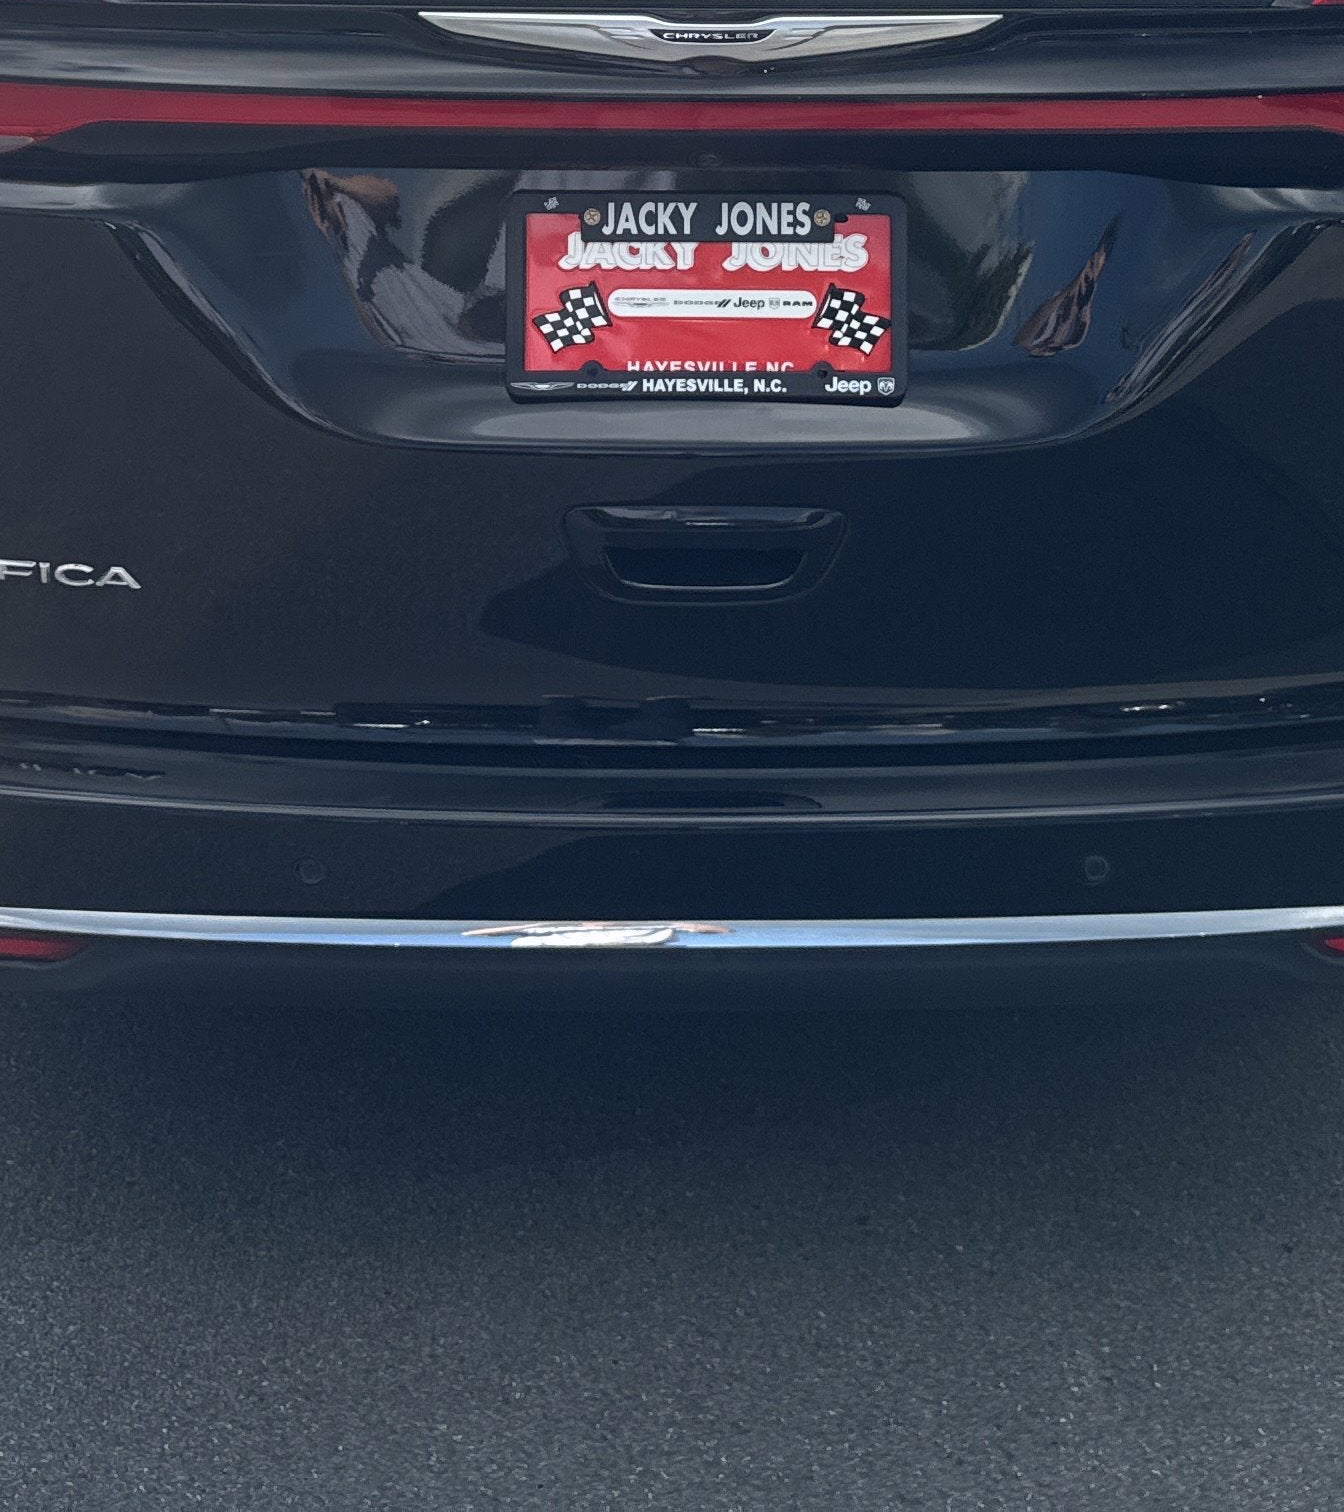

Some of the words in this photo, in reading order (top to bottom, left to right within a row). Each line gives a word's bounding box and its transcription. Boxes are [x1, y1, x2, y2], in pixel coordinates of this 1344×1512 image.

[662, 32, 759, 40] CHRYSLER
[601, 201, 698, 236] JACKY
[715, 201, 812, 236] JONES
[558, 233, 700, 271] JACKY
[722, 233, 869, 272] JONES
[733, 297, 765, 310] Jeep
[642, 378, 749, 394] HAYESVILLE,
[754, 378, 787, 392] N.C.
[825, 377, 871, 395] Jeep
